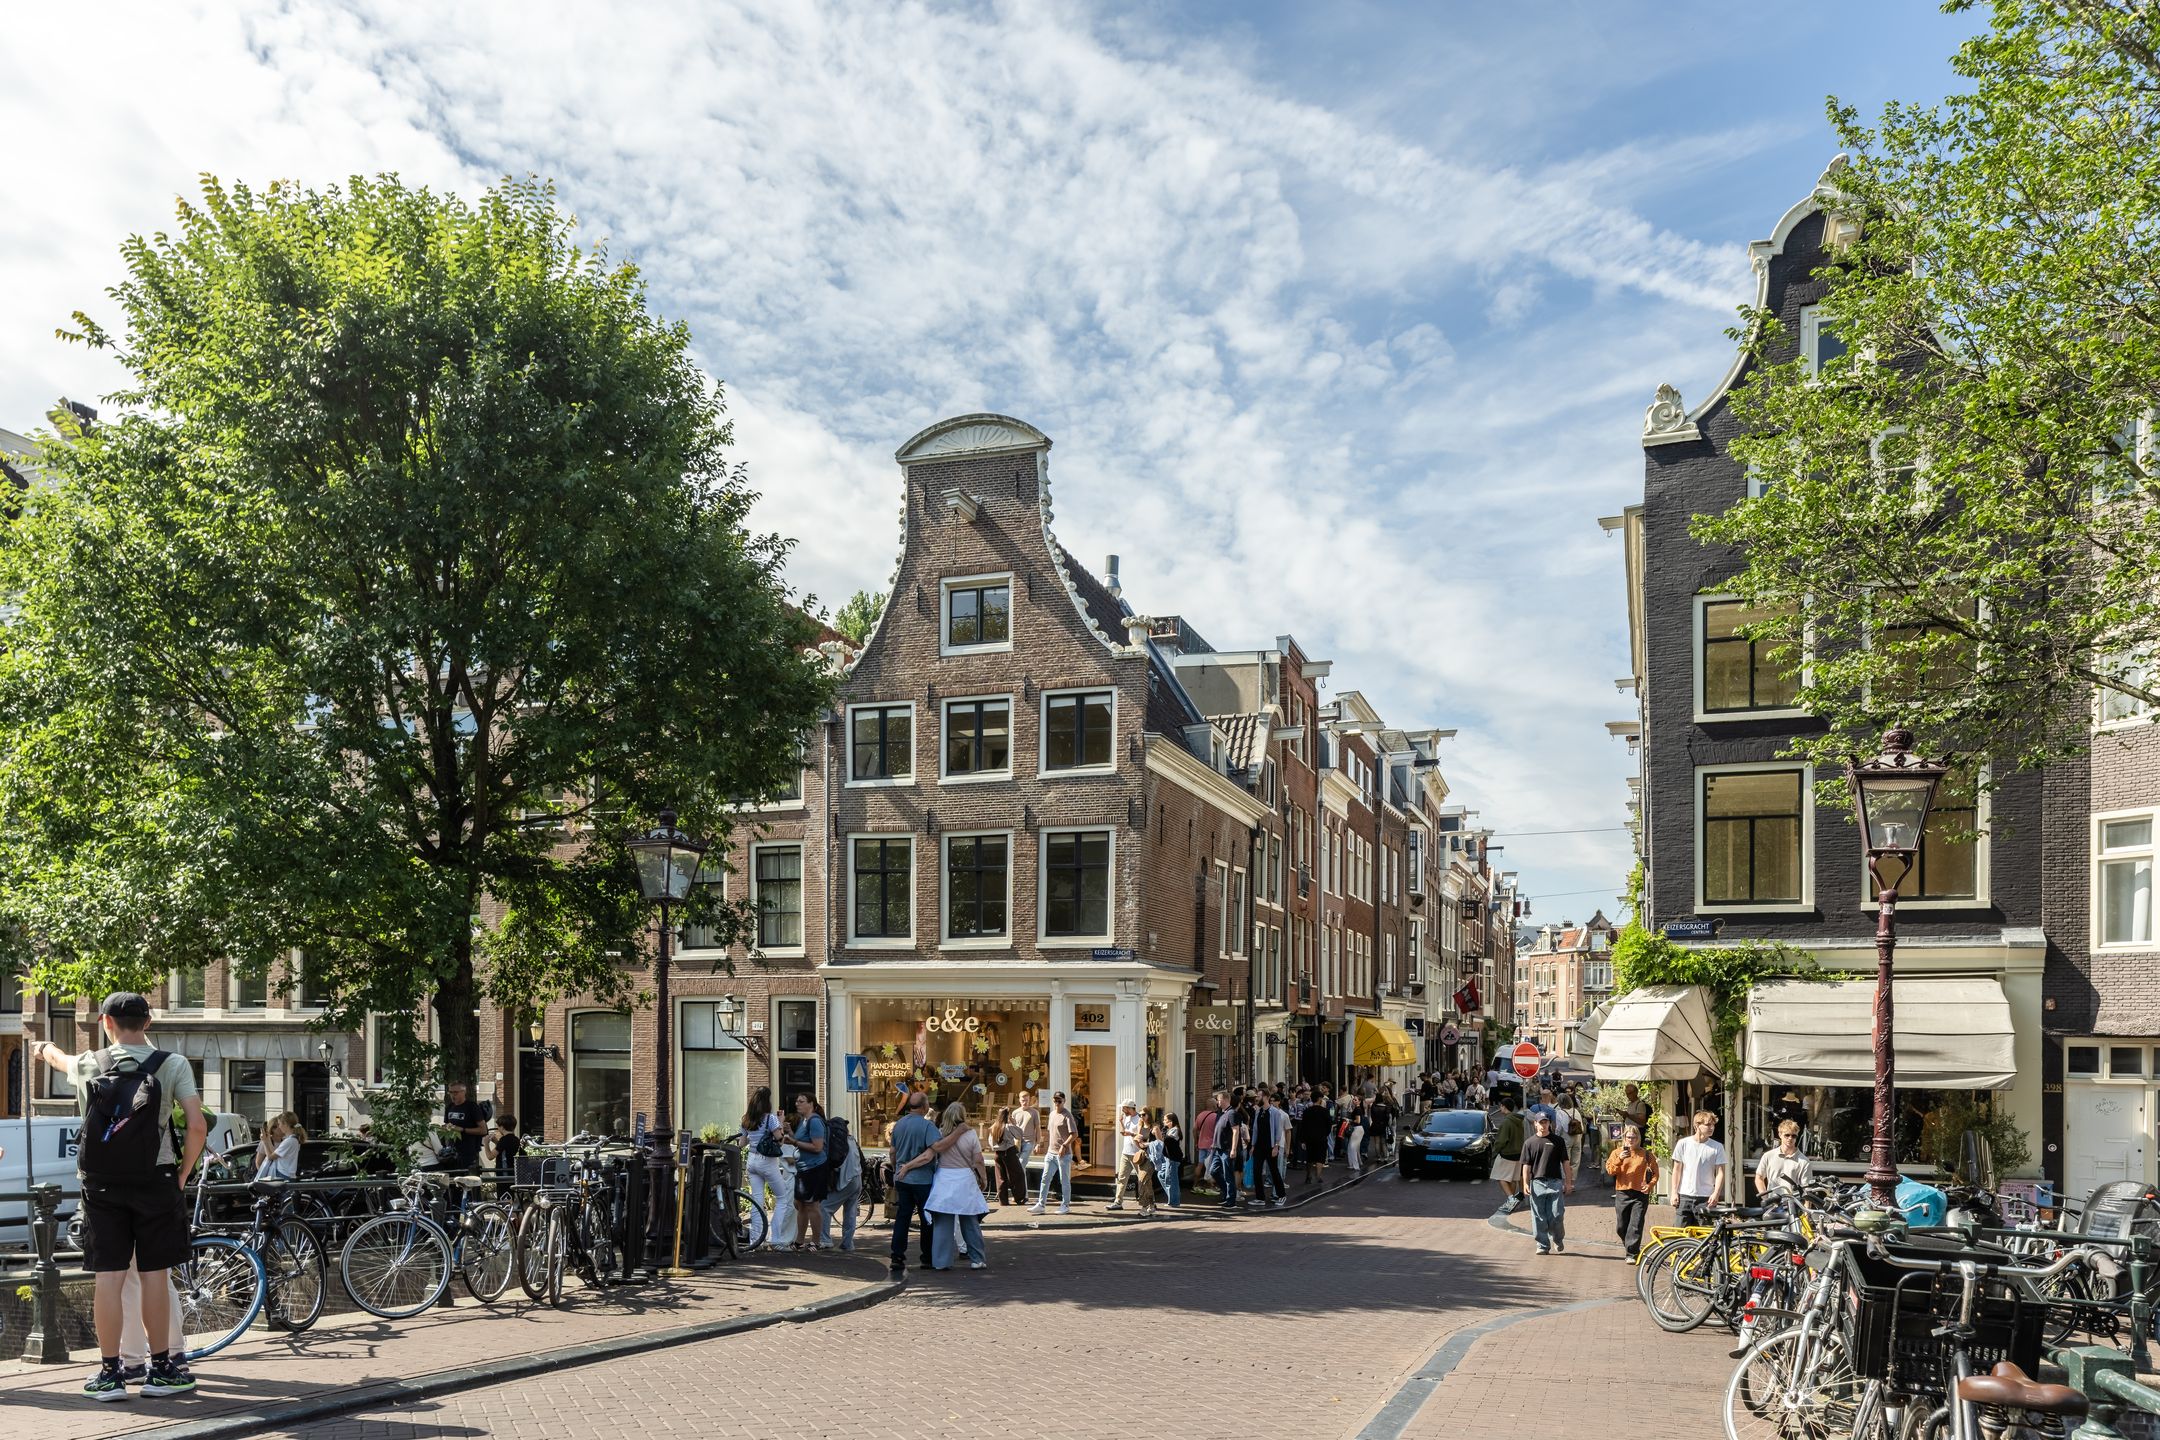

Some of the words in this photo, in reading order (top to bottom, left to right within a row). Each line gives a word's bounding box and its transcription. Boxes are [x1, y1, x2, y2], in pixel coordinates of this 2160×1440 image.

[1662, 922, 1710, 931] KEIZERSGRACHT
[925, 1008, 979, 1033] e&e
[1081, 1013, 1105, 1023] 402
[1194, 1013, 1232, 1030] e&e
[870, 1062, 911, 1070] HAND-MADE
[870, 1069, 908, 1077] JEWELLERY
[2044, 1083, 2062, 1091] 398
